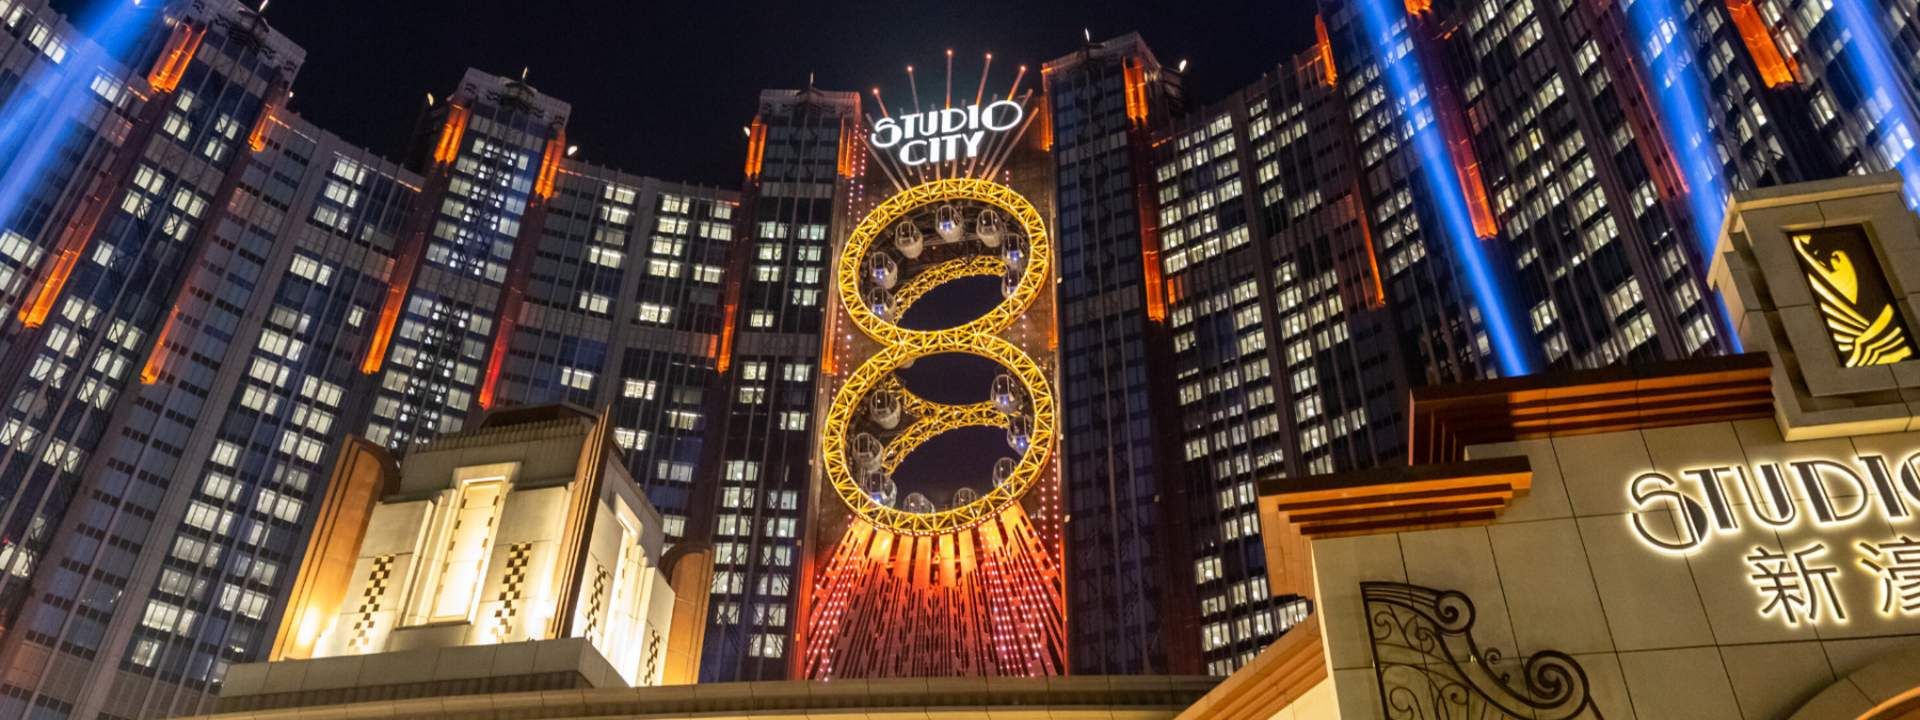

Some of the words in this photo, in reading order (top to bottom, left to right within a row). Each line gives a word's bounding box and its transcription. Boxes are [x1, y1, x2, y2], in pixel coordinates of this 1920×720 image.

[871, 100, 1023, 148] STUDIO
[899, 130, 985, 166] CITY
[1631, 451, 1920, 550] STUDI
